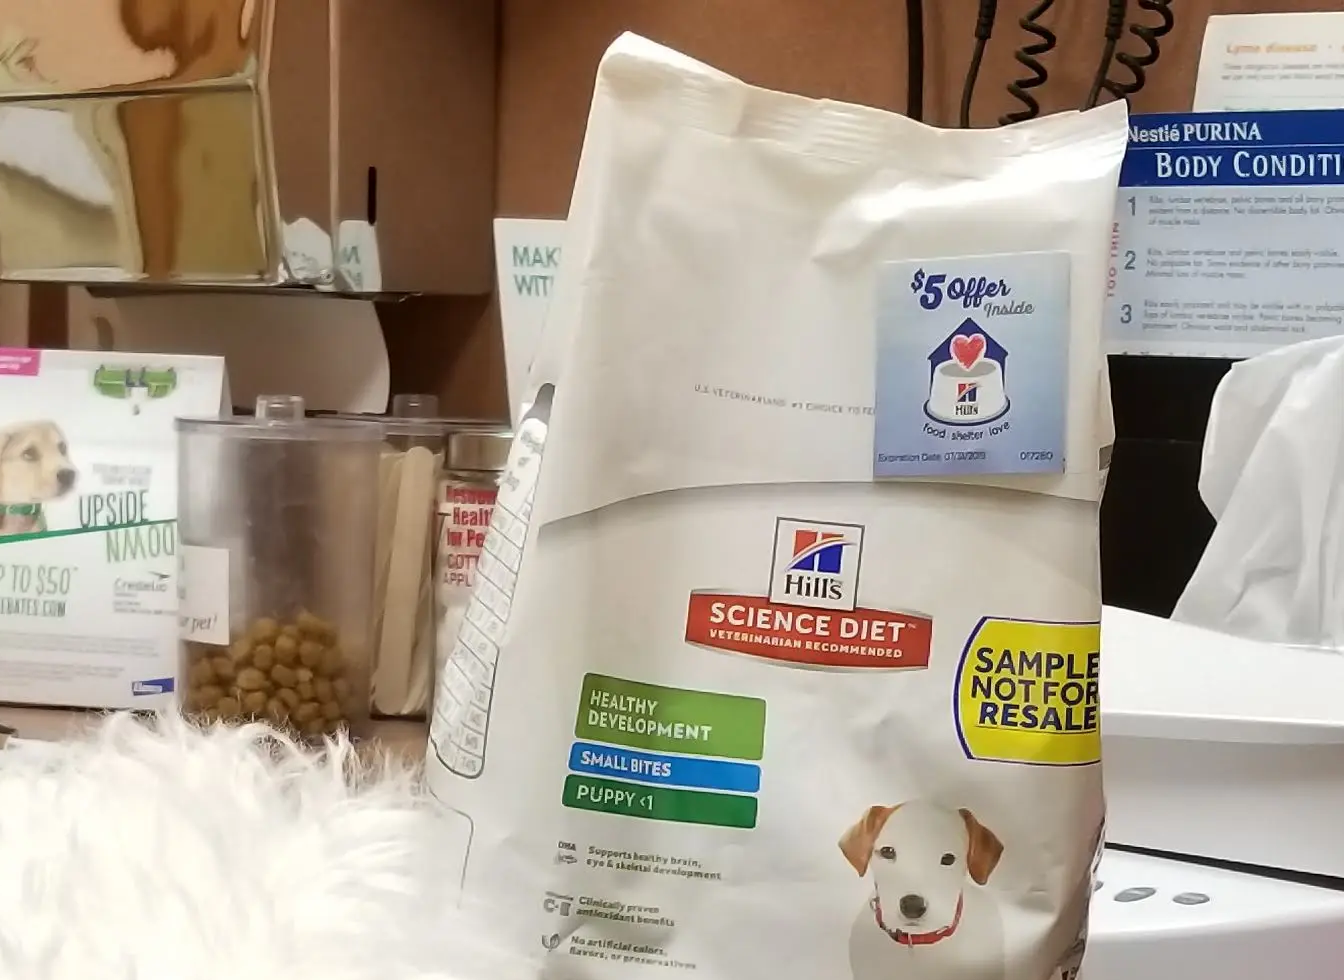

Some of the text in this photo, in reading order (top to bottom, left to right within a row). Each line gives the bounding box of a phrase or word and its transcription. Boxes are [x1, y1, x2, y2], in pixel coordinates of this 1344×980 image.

[1128, 122, 1263, 143] Nestlé PURINA
[1157, 151, 1222, 179] BODY
[1127, 196, 1137, 216] 1
[512, 246, 561, 268] MAK
[1124, 250, 1136, 270] 2
[514, 275, 554, 296] WIT
[911, 268, 1012, 311] $5 Offer
[984, 300, 1036, 318] Inside
[1120, 303, 1133, 324] 3
[922, 422, 946, 439] food
[989, 421, 1011, 437] love
[452, 507, 492, 527] Healt
[466, 529, 485, 548] Pe
[447, 553, 480, 570] COTT
[11, 564, 32, 594] TO
[443, 572, 473, 588] APPL
[783, 574, 844, 601] Hill's
[709, 602, 906, 643] SCIENCE DIET
[708, 629, 903, 659] VETERINARIAN RECOMMENDED
[974, 647, 1100, 680] SAMPLE
[970, 676, 1099, 706] NOT FOR
[590, 689, 659, 716] HEALTHY
[588, 709, 712, 741] DEVELOPMENT
[978, 702, 1097, 731] RESALE
[580, 750, 672, 777] SMALL BITES
[576, 784, 654, 811] PUPPY <1
[558, 841, 577, 851] DHA
[588, 846, 632, 861] Supports
[633, 852, 669, 866] healthy
[586, 857, 605, 869] eye
[606, 860, 614, 869] &
[615, 861, 652, 873] skeletal
[578, 896, 626, 912] Clinically
[627, 903, 660, 915] proven
[575, 908, 676, 927] antioxidant benefits
[568, 946, 609, 961] flavors,
[610, 953, 622, 962] or
[571, 935, 668, 957] No artificial colors,
